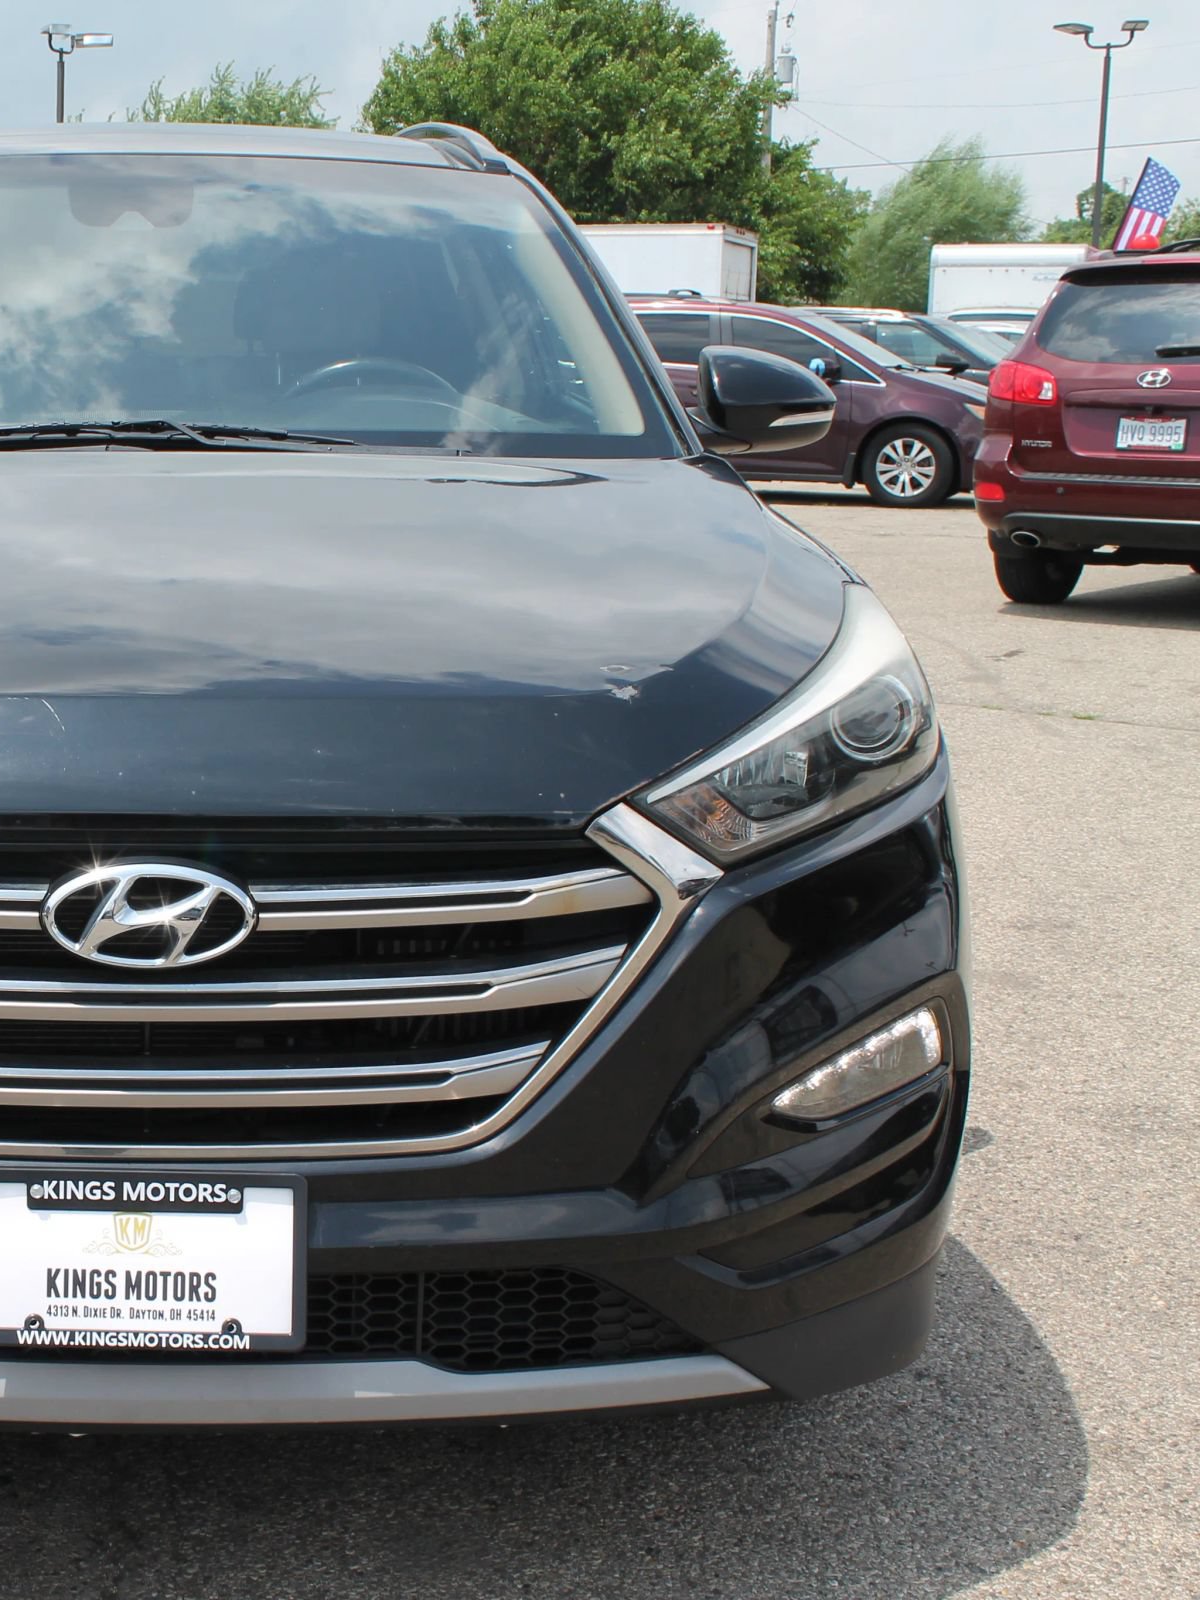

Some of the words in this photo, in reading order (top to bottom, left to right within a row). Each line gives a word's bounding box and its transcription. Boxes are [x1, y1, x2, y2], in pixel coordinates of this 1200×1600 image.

[1149, 425, 1182, 442] 9995
[43, 1180, 116, 1201] KINGS
[122, 1182, 227, 1203] MOTORS
[46, 1268, 117, 1300] KINGS
[124, 1270, 217, 1303] MOTORS
[46, 1304, 69, 1317] 4313
[71, 1305, 81, 1318] N.
[169, 1308, 182, 1321] OH
[186, 1308, 216, 1322] 45414
[16, 1329, 250, 1350] WWW.KINGSMOTORS.COM
